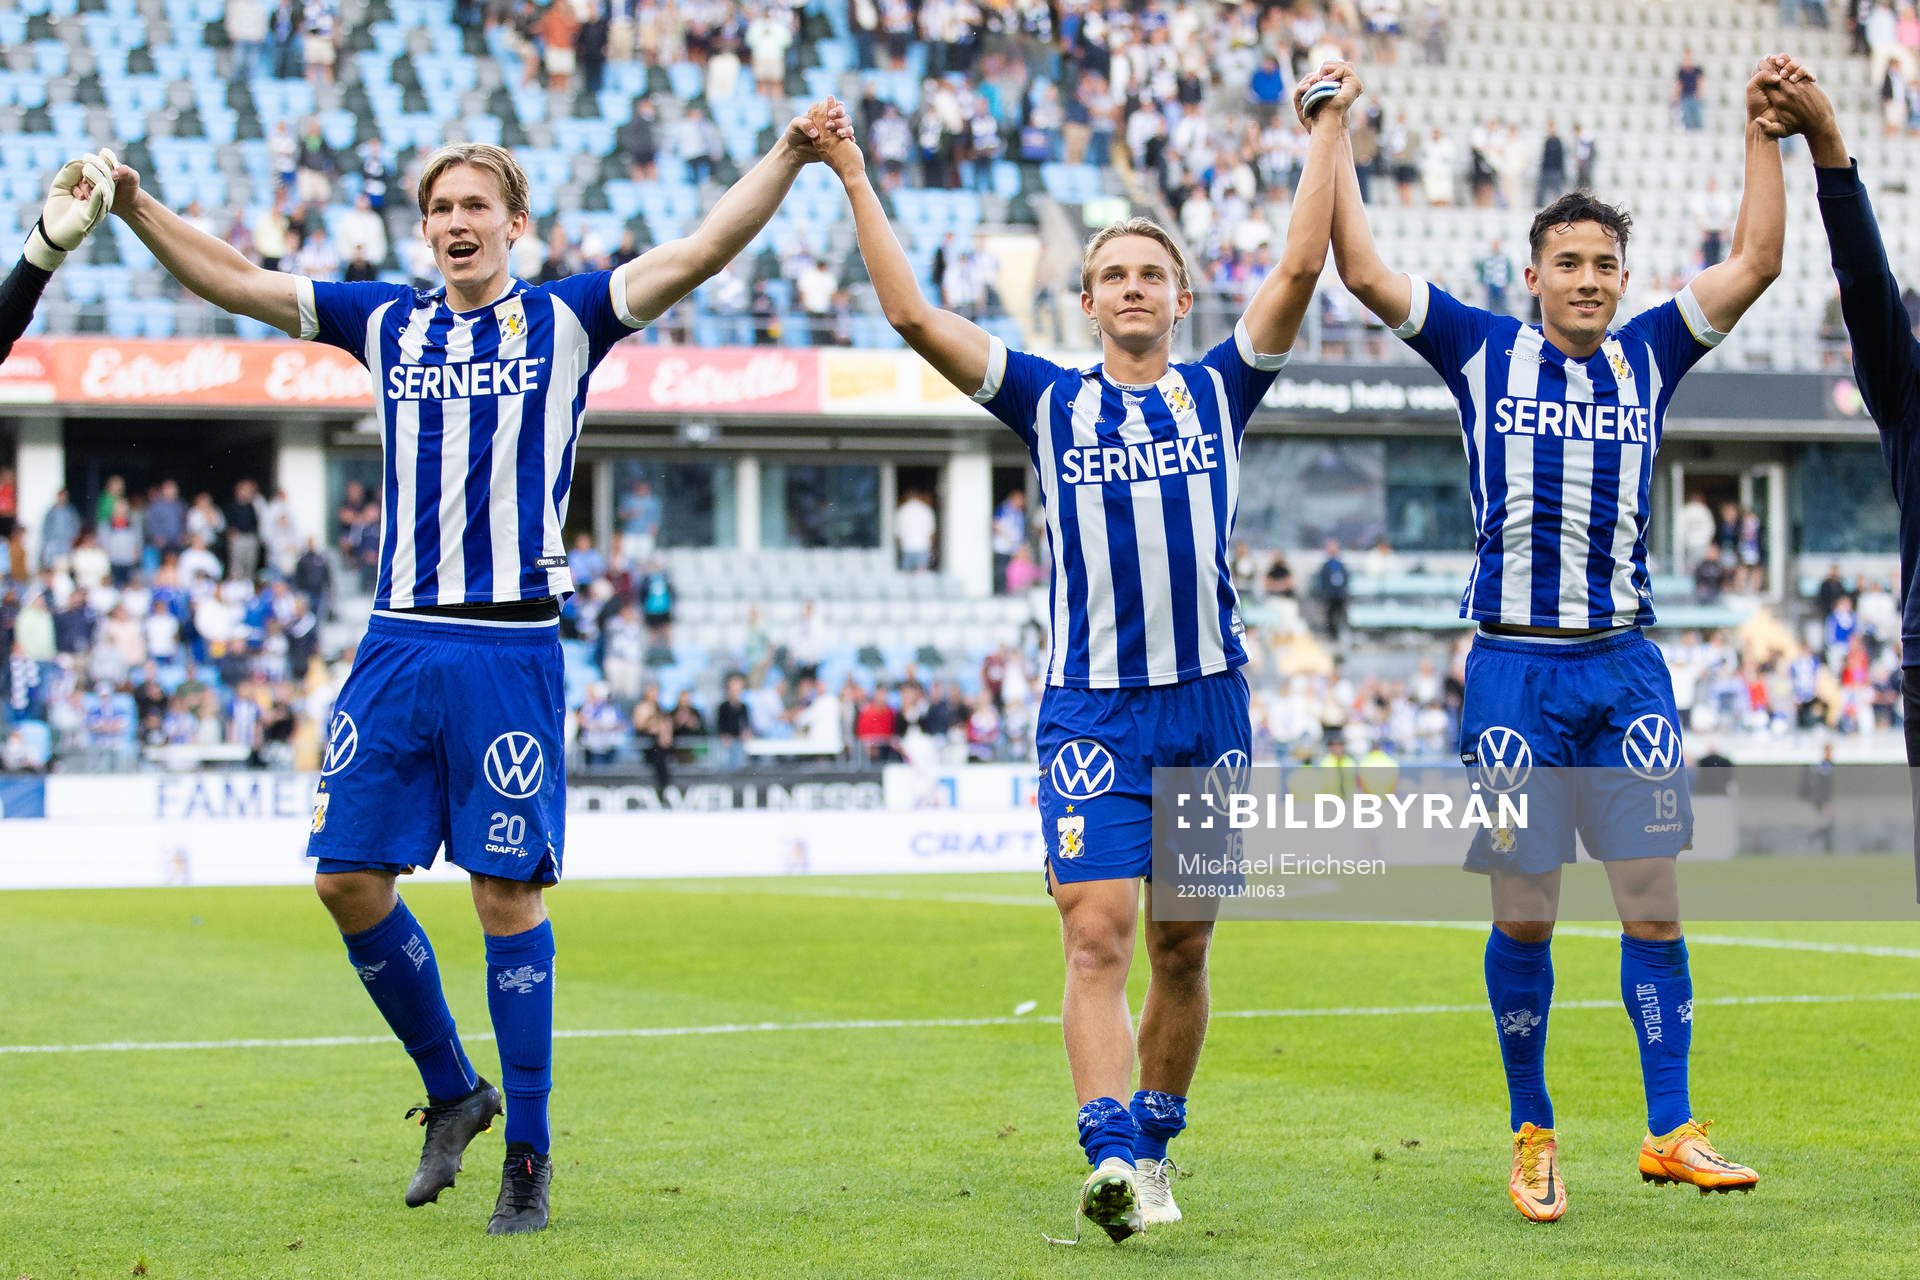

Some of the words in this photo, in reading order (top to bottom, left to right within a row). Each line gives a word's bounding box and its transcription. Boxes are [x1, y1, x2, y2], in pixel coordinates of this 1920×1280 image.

[387, 358, 540, 400] SERNEKE
[1494, 397, 1648, 442] SERNEKE
[1062, 434, 1218, 484] SERNEKE
[155, 776, 312, 820] FAME
[1652, 788, 1677, 820] 19
[488, 811, 526, 845] 20
[1644, 823, 1678, 833] CRAFT
[485, 843, 519, 855] CRAFT
